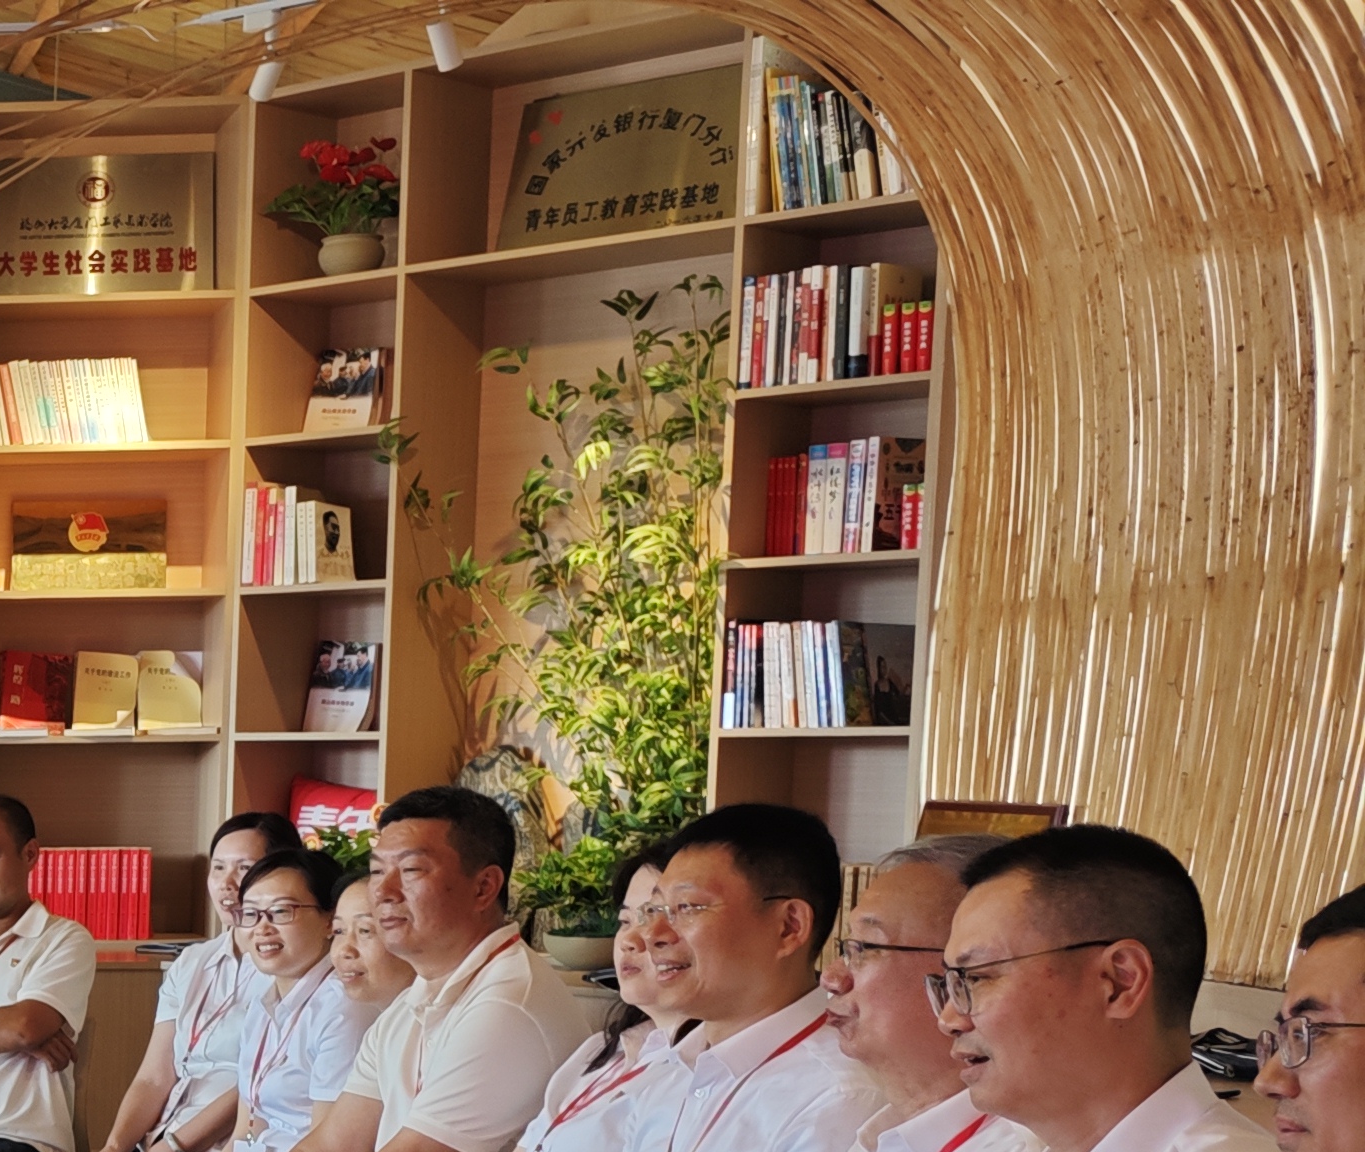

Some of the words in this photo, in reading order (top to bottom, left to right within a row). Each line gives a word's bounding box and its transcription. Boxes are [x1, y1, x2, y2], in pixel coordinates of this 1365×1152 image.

[525, 181, 720, 233] 青年员工教育实践基地
